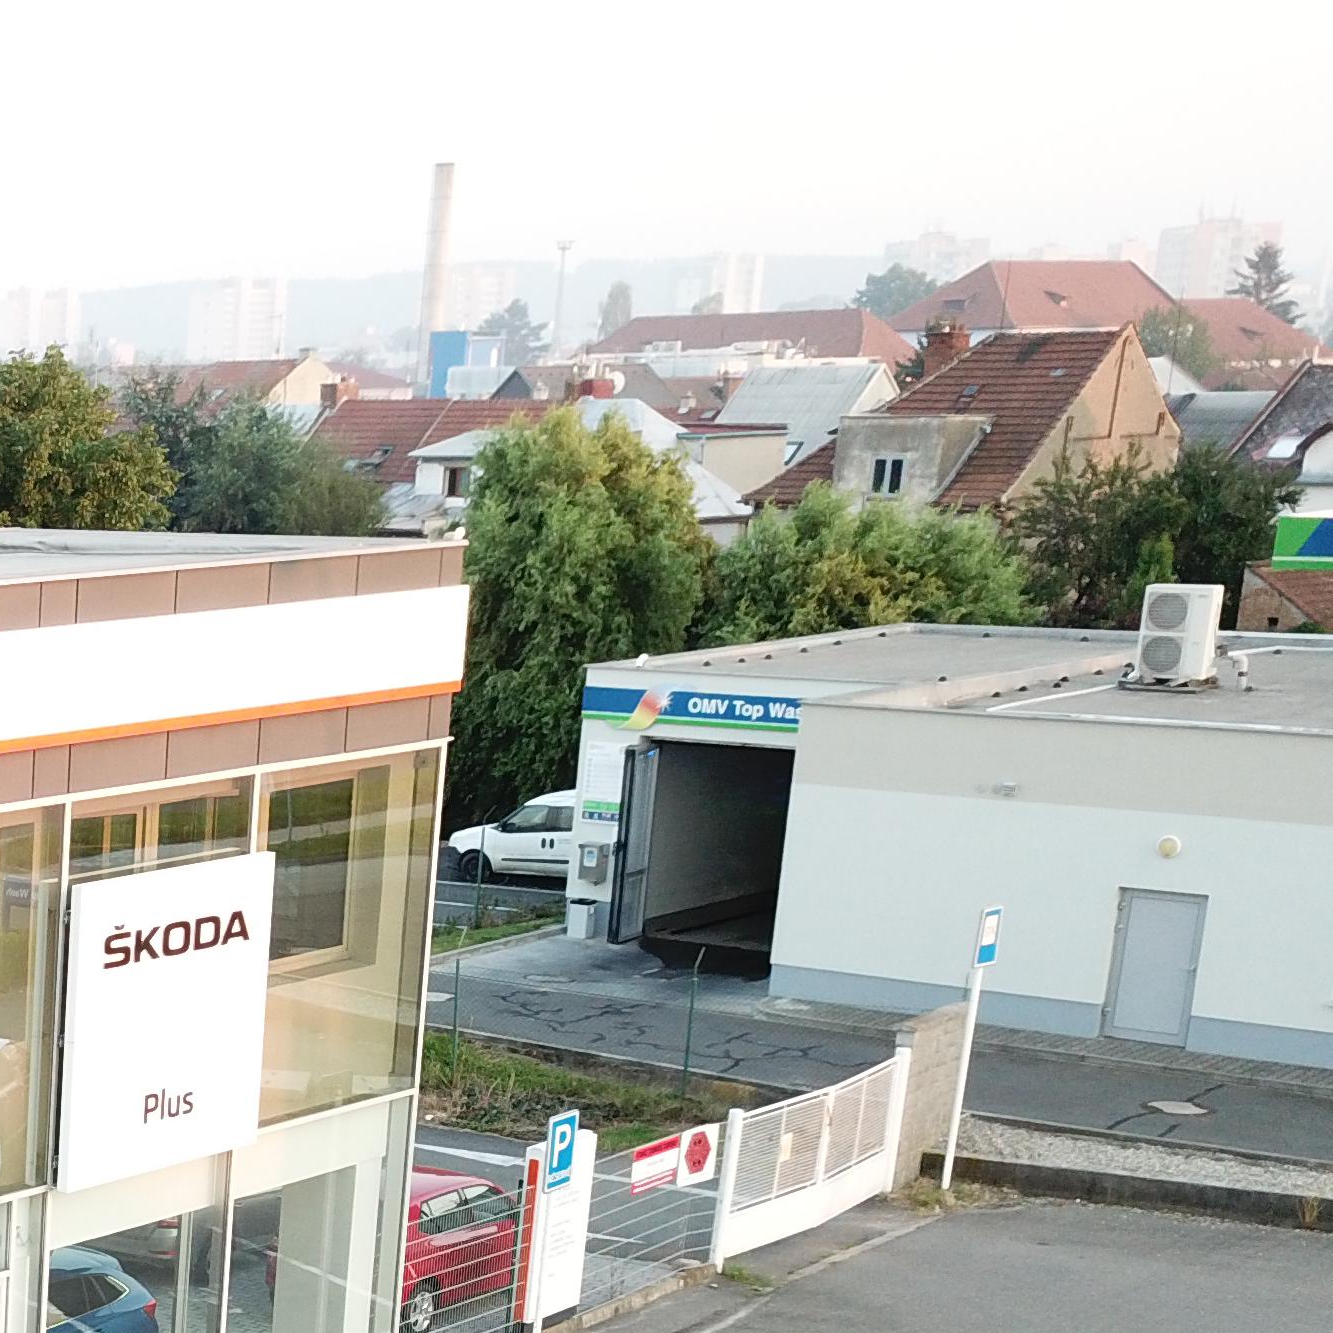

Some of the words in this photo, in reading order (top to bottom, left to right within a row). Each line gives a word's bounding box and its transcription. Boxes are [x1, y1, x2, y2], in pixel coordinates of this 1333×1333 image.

[687, 697, 729, 715] OMV
[733, 700, 764, 720] Top
[103, 910, 250, 969] ŠKODA
[143, 1088, 194, 1124] Plus
[552, 1123, 572, 1169] P
